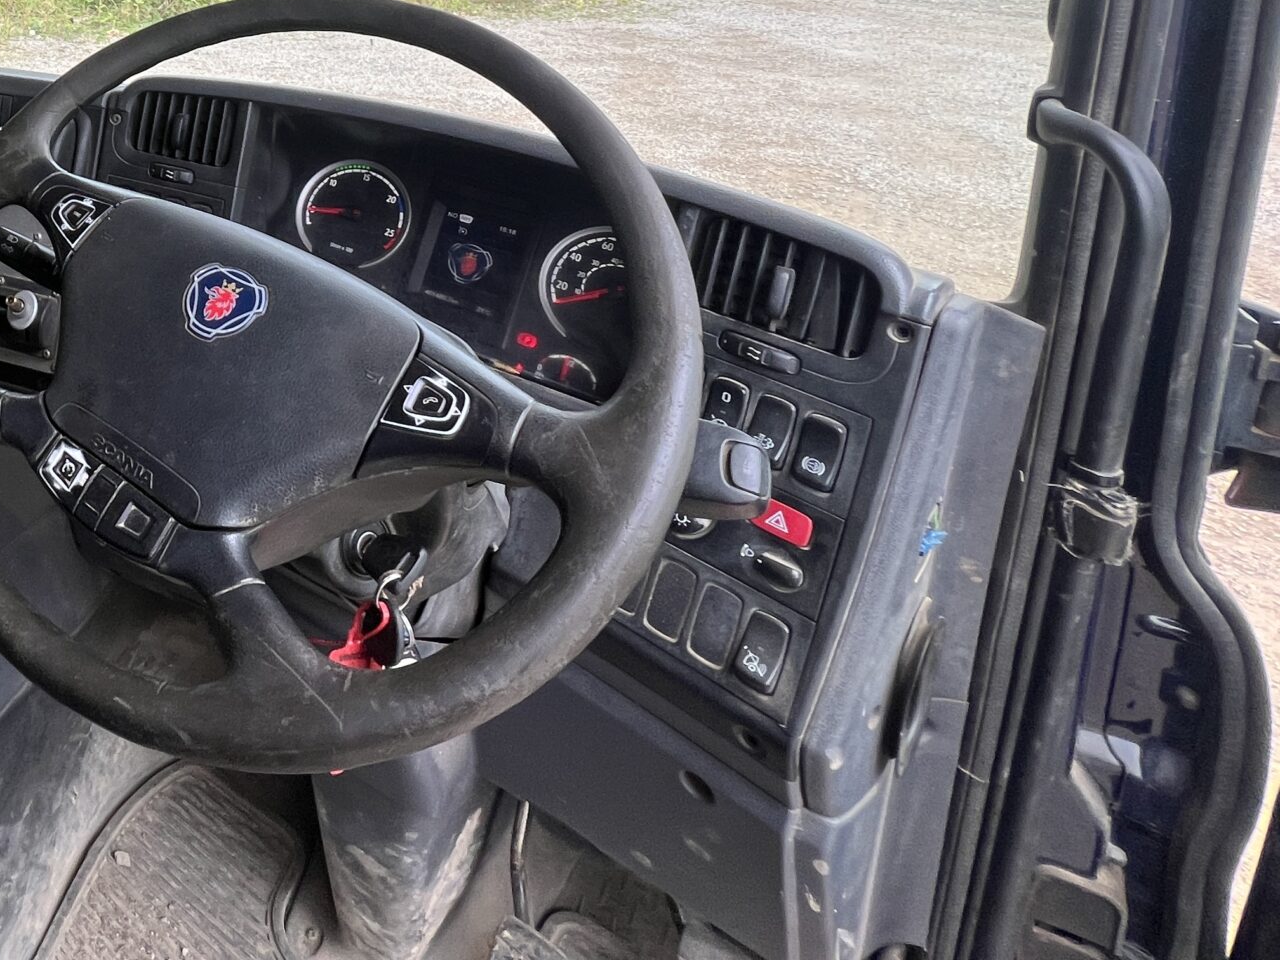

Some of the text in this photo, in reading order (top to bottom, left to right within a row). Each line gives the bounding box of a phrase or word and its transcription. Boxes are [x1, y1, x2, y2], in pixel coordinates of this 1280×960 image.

[329, 179, 337, 187] 10
[386, 195, 396, 204] 20
[384, 228, 395, 237] 25
[601, 242, 614, 251] 60
[569, 252, 582, 262] 40
[556, 280, 568, 290] 20
